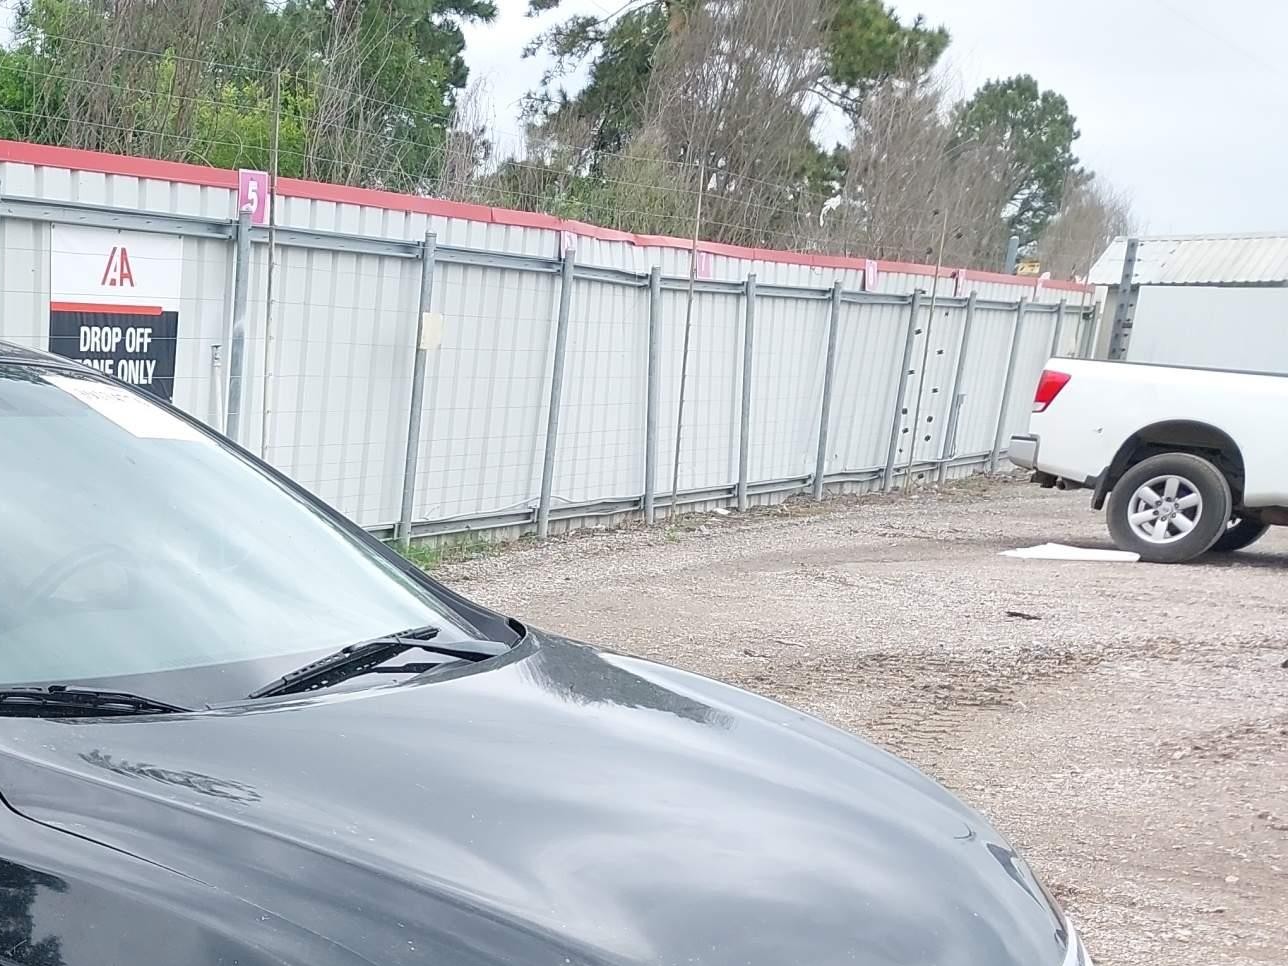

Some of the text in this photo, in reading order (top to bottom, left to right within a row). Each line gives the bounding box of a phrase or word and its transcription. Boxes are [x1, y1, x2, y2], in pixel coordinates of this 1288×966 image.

[242, 180, 259, 214] 5
[79, 325, 153, 353] DROP OFF
[117, 359, 157, 385] ONLY
